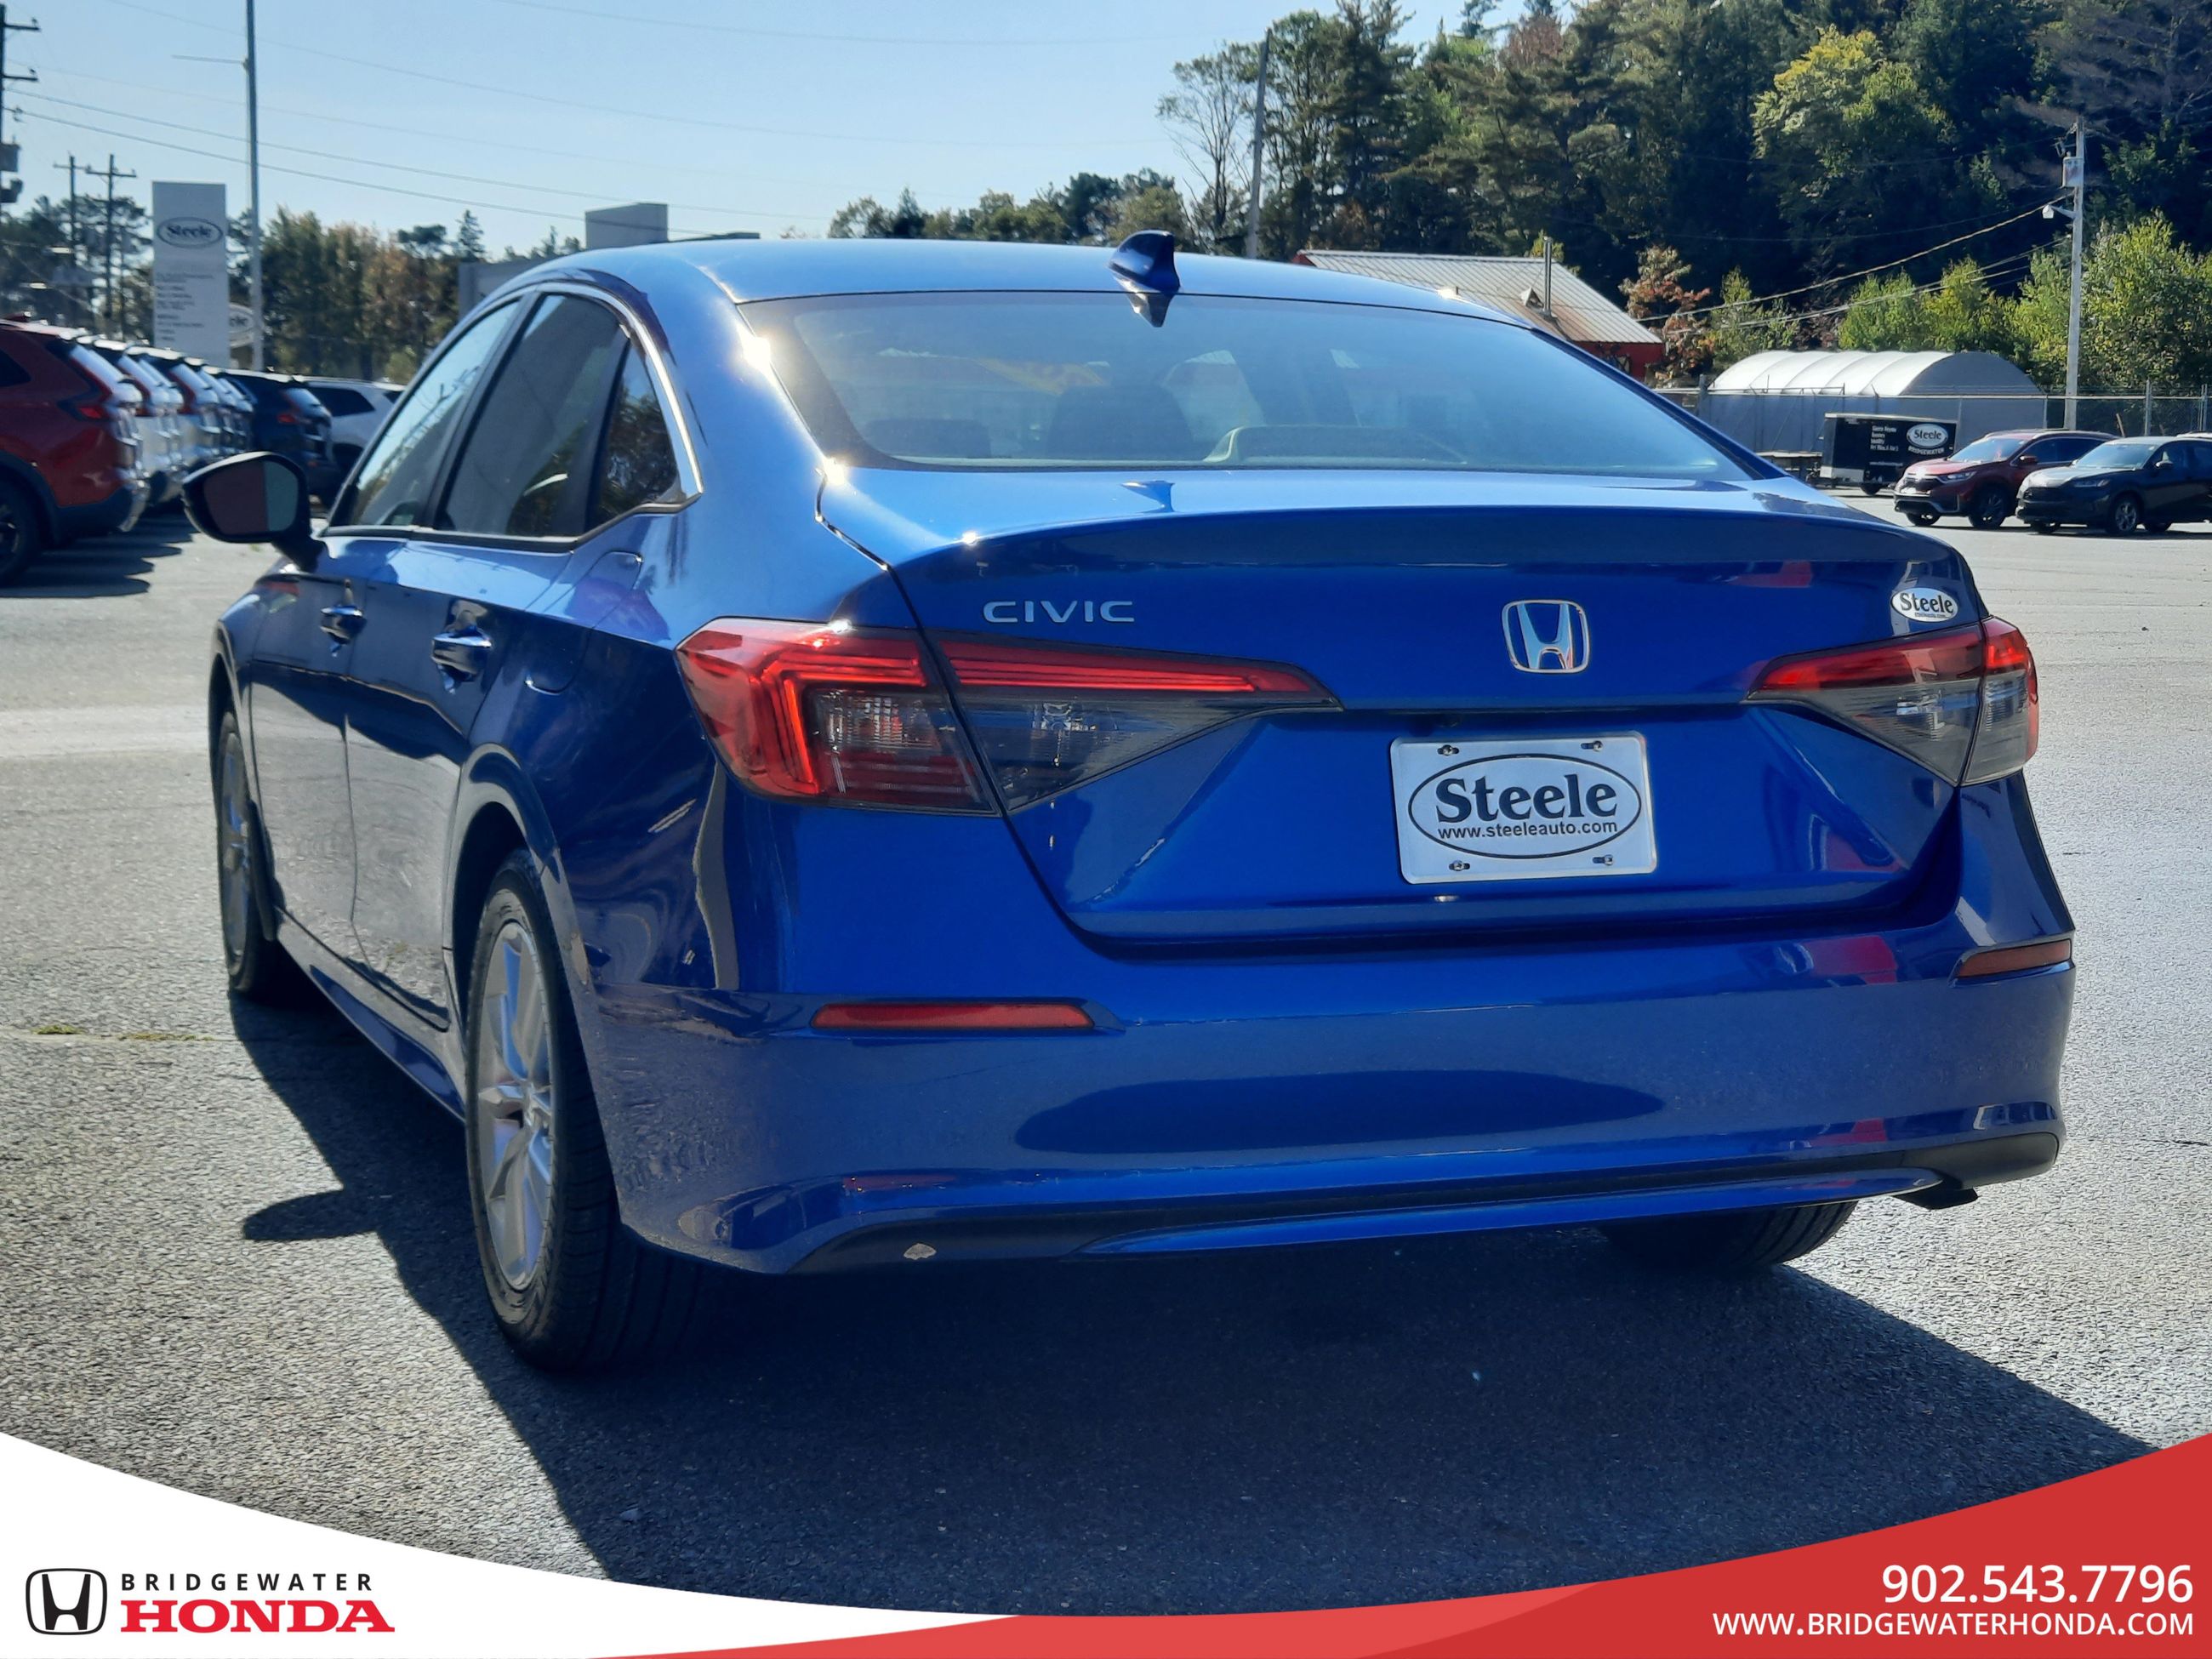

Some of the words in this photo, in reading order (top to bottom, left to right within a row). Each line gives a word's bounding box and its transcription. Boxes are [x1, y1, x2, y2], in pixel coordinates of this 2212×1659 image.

[1913, 429, 1942, 440] Steele
[983, 600, 1136, 624] CIVIC
[1899, 592, 1954, 613] Steele
[1435, 773, 1618, 824] Steele
[1438, 820, 1618, 840] www.steeleauto.com
